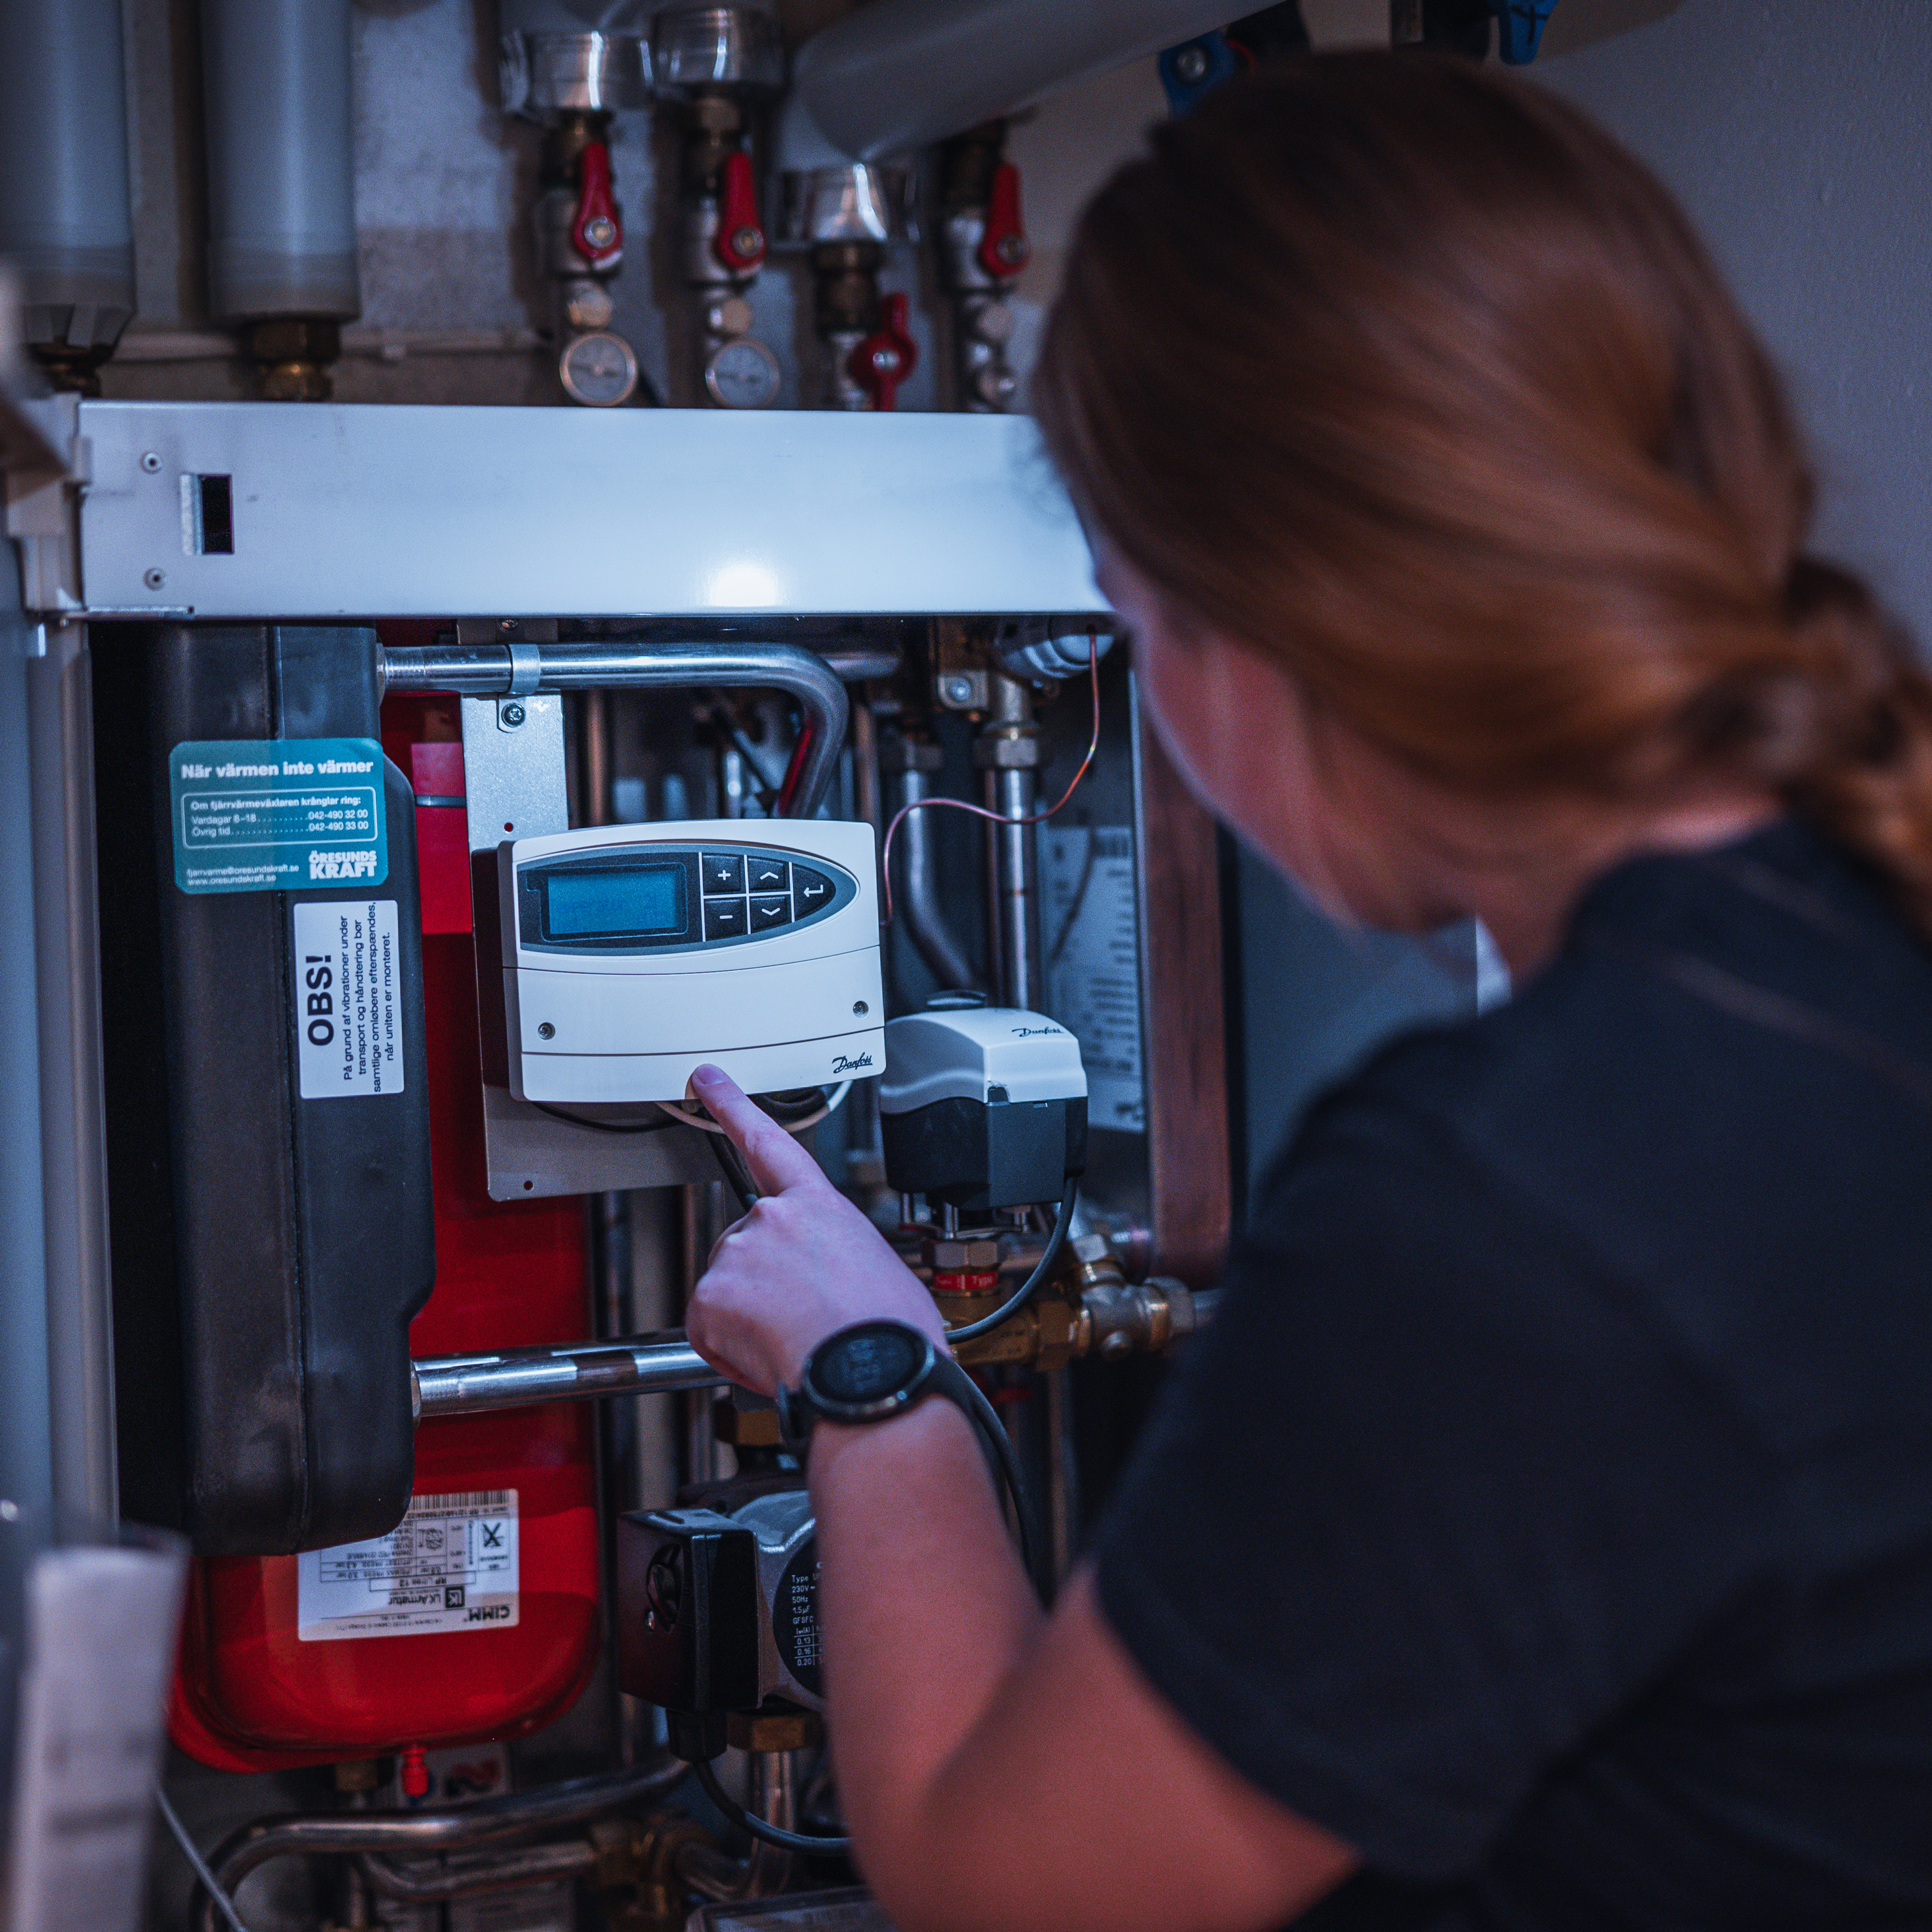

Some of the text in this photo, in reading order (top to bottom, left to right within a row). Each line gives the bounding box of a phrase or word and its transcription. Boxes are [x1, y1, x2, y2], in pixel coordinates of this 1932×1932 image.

[181, 760, 374, 779] När värmen inte värmer
[191, 796, 361, 810] Om fjärrvärmeväxlaren krånglar ring:
[192, 814, 232, 825] Vardagar
[344, 810, 356, 819] 32
[357, 809, 368, 818] 00
[192, 826, 231, 837] Övrig tid
[345, 822, 357, 830] 33
[357, 821, 369, 830] 00
[309, 850, 377, 863] ÖRESUNDS
[310, 862, 377, 879] KRAFT
[188, 875, 276, 886] www.oresundskraft.se
[355, 942, 365, 1003] håndtering
[306, 955, 334, 1046] OBS!
[340, 915, 353, 1080] På grund af vibrationer under
[368, 902, 382, 1093] samtlige omløbere efterspændes,
[382, 932, 394, 1060] når uniten er monteret.
[358, 1006, 366, 1021] og
[1012, 1026, 1064, 1037] Danfoss
[357, 1024, 366, 1075] transport
[832, 1052, 873, 1073] Danfoss
[792, 1575, 809, 1583] Type
[388, 1593, 429, 1605] Armatur
[469, 1606, 510, 1622] CIMM
[796, 1637, 811, 1645] 0.13
[797, 1658, 812, 1666] 0.20
